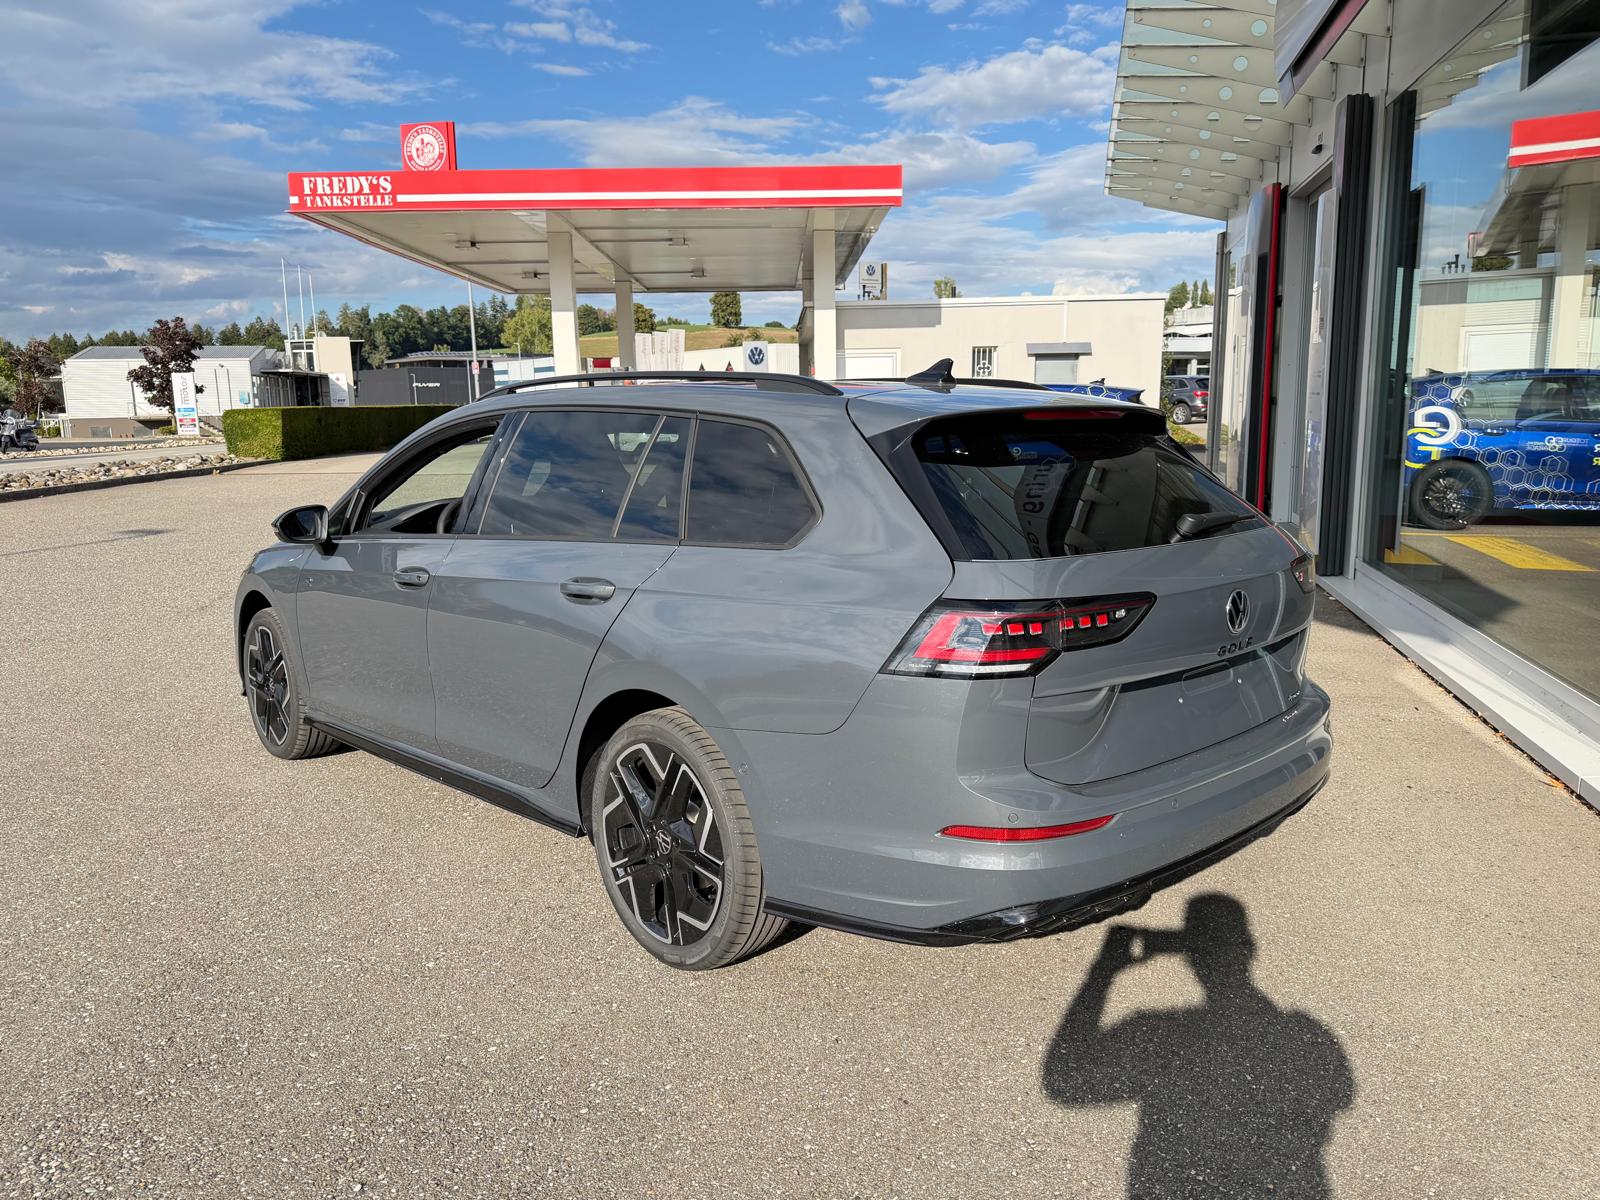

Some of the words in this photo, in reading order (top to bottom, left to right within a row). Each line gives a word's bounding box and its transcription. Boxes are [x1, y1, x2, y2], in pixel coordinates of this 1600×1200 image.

[302, 175, 392, 195] FREDY'S
[304, 194, 393, 207] TANKSTELLE
[1217, 636, 1254, 657] GOLF
